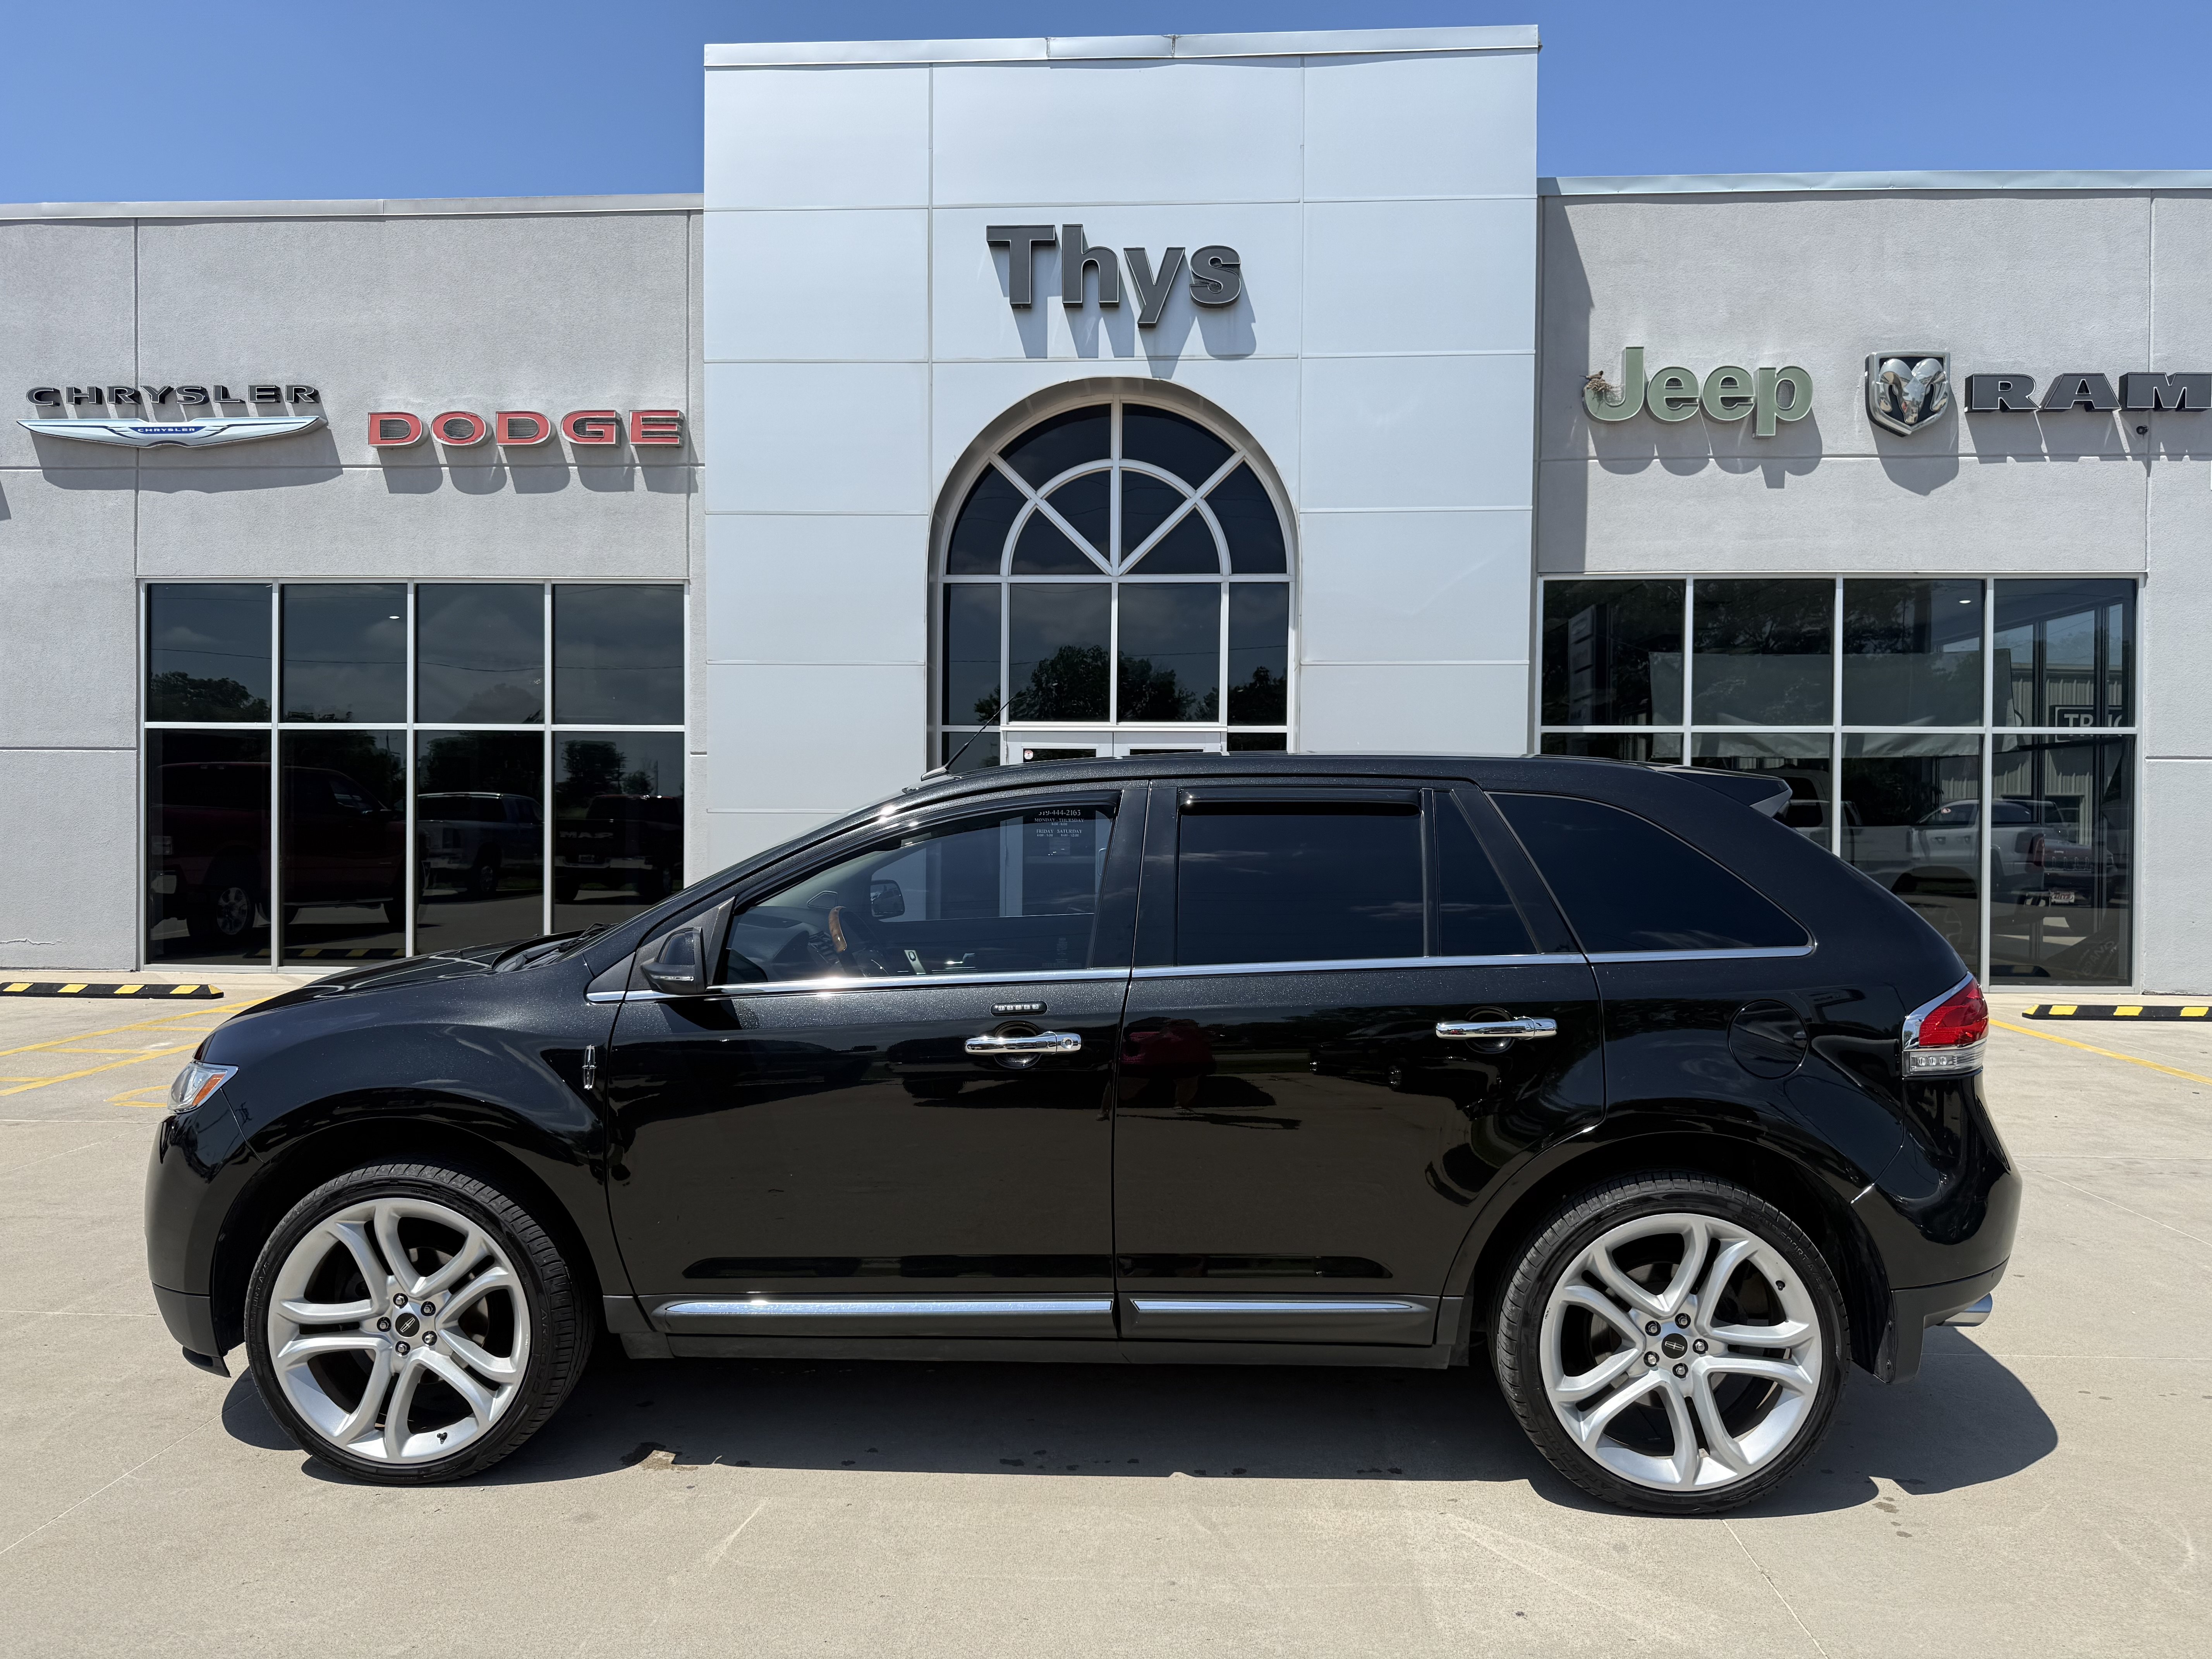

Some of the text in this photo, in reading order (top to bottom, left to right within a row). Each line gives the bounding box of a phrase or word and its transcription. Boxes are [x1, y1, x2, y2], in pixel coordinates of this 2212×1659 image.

[986, 224, 1241, 328] Thys
[26, 384, 319, 406] CHRYSLER
[1582, 347, 1813, 438] Jeep
[1965, 372, 2212, 412] RAM
[368, 410, 683, 447] DODGE
[1781, 1231, 1809, 1260] SPORT
[259, 1261, 270, 1283] A/S
[532, 1308, 548, 1393] ARROYO
